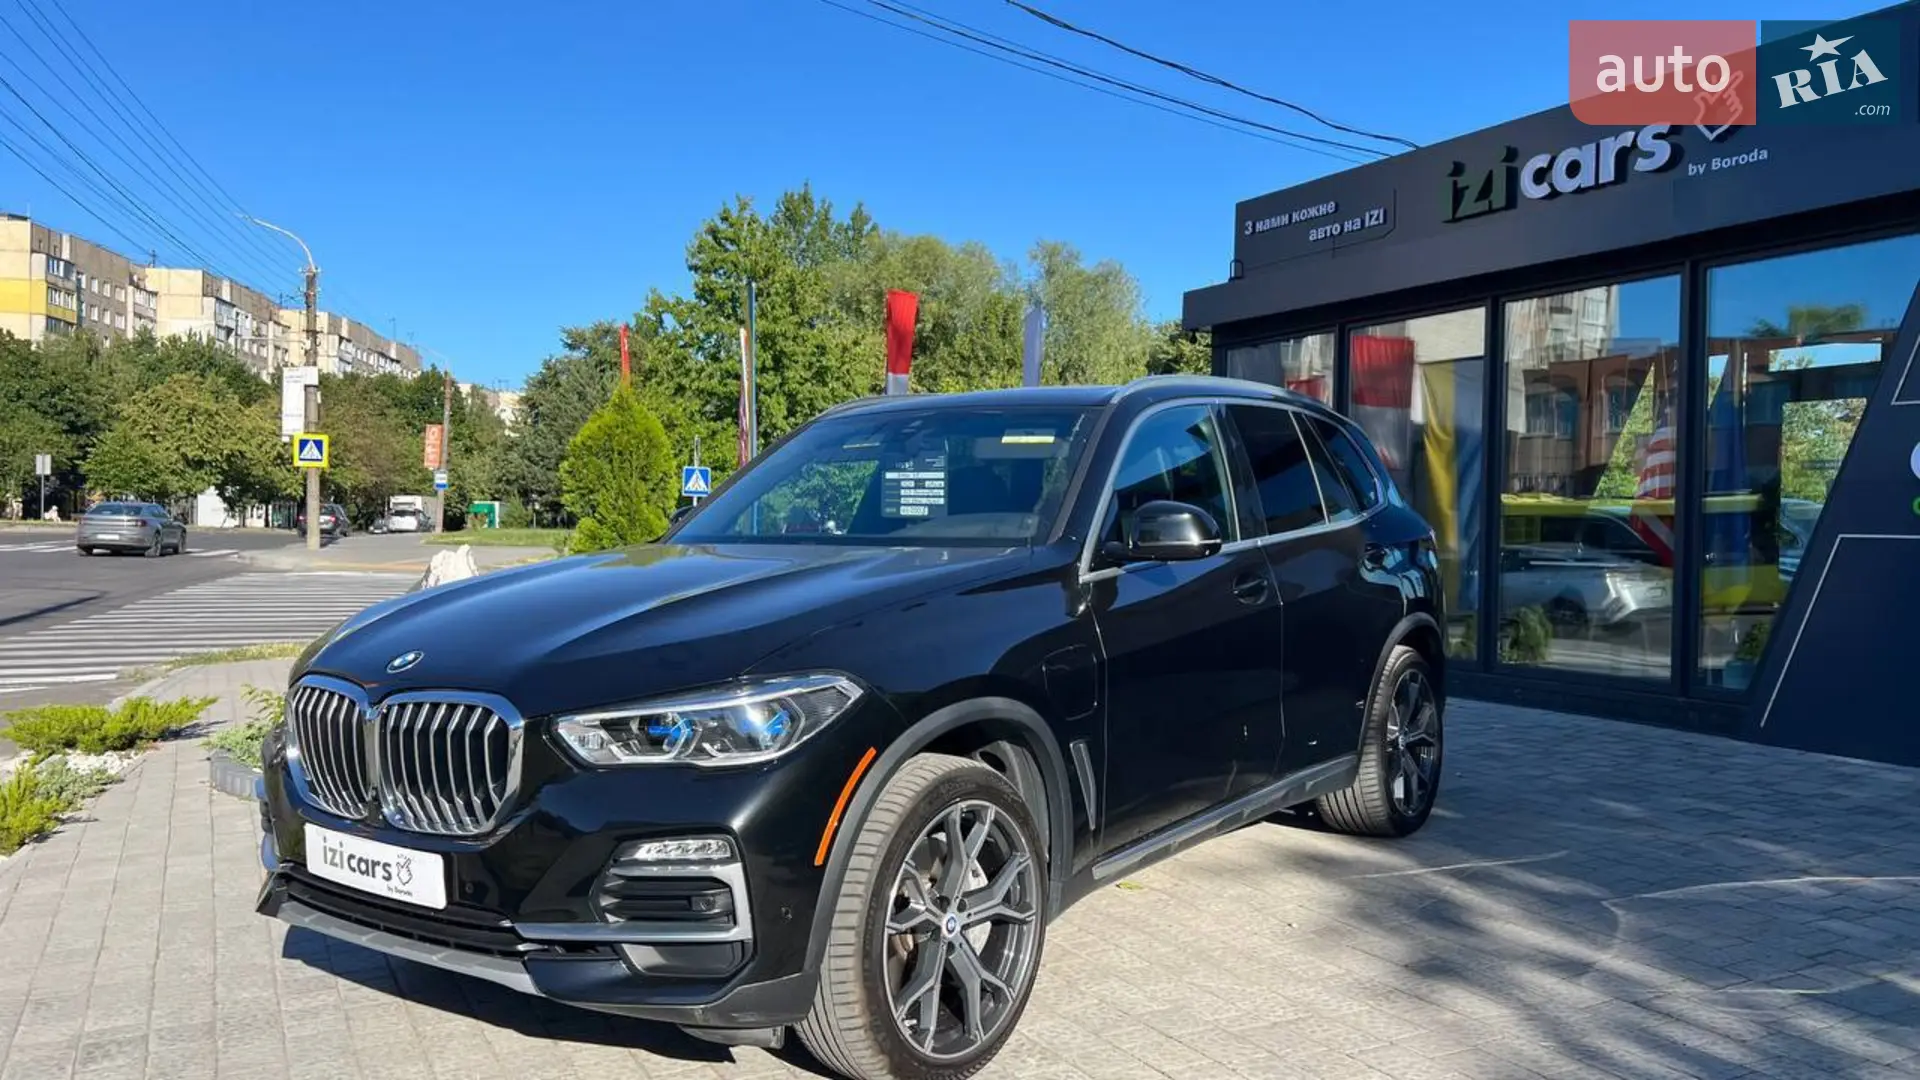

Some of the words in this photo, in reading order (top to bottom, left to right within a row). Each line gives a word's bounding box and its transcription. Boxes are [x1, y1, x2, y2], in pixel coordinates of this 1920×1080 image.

[1688, 161, 1705, 177] by
[1711, 147, 1768, 171] Boroda
[1255, 213, 1290, 232] нами
[1292, 201, 1336, 223] кожне
[1308, 223, 1341, 241] авто
[1343, 217, 1361, 233] на
